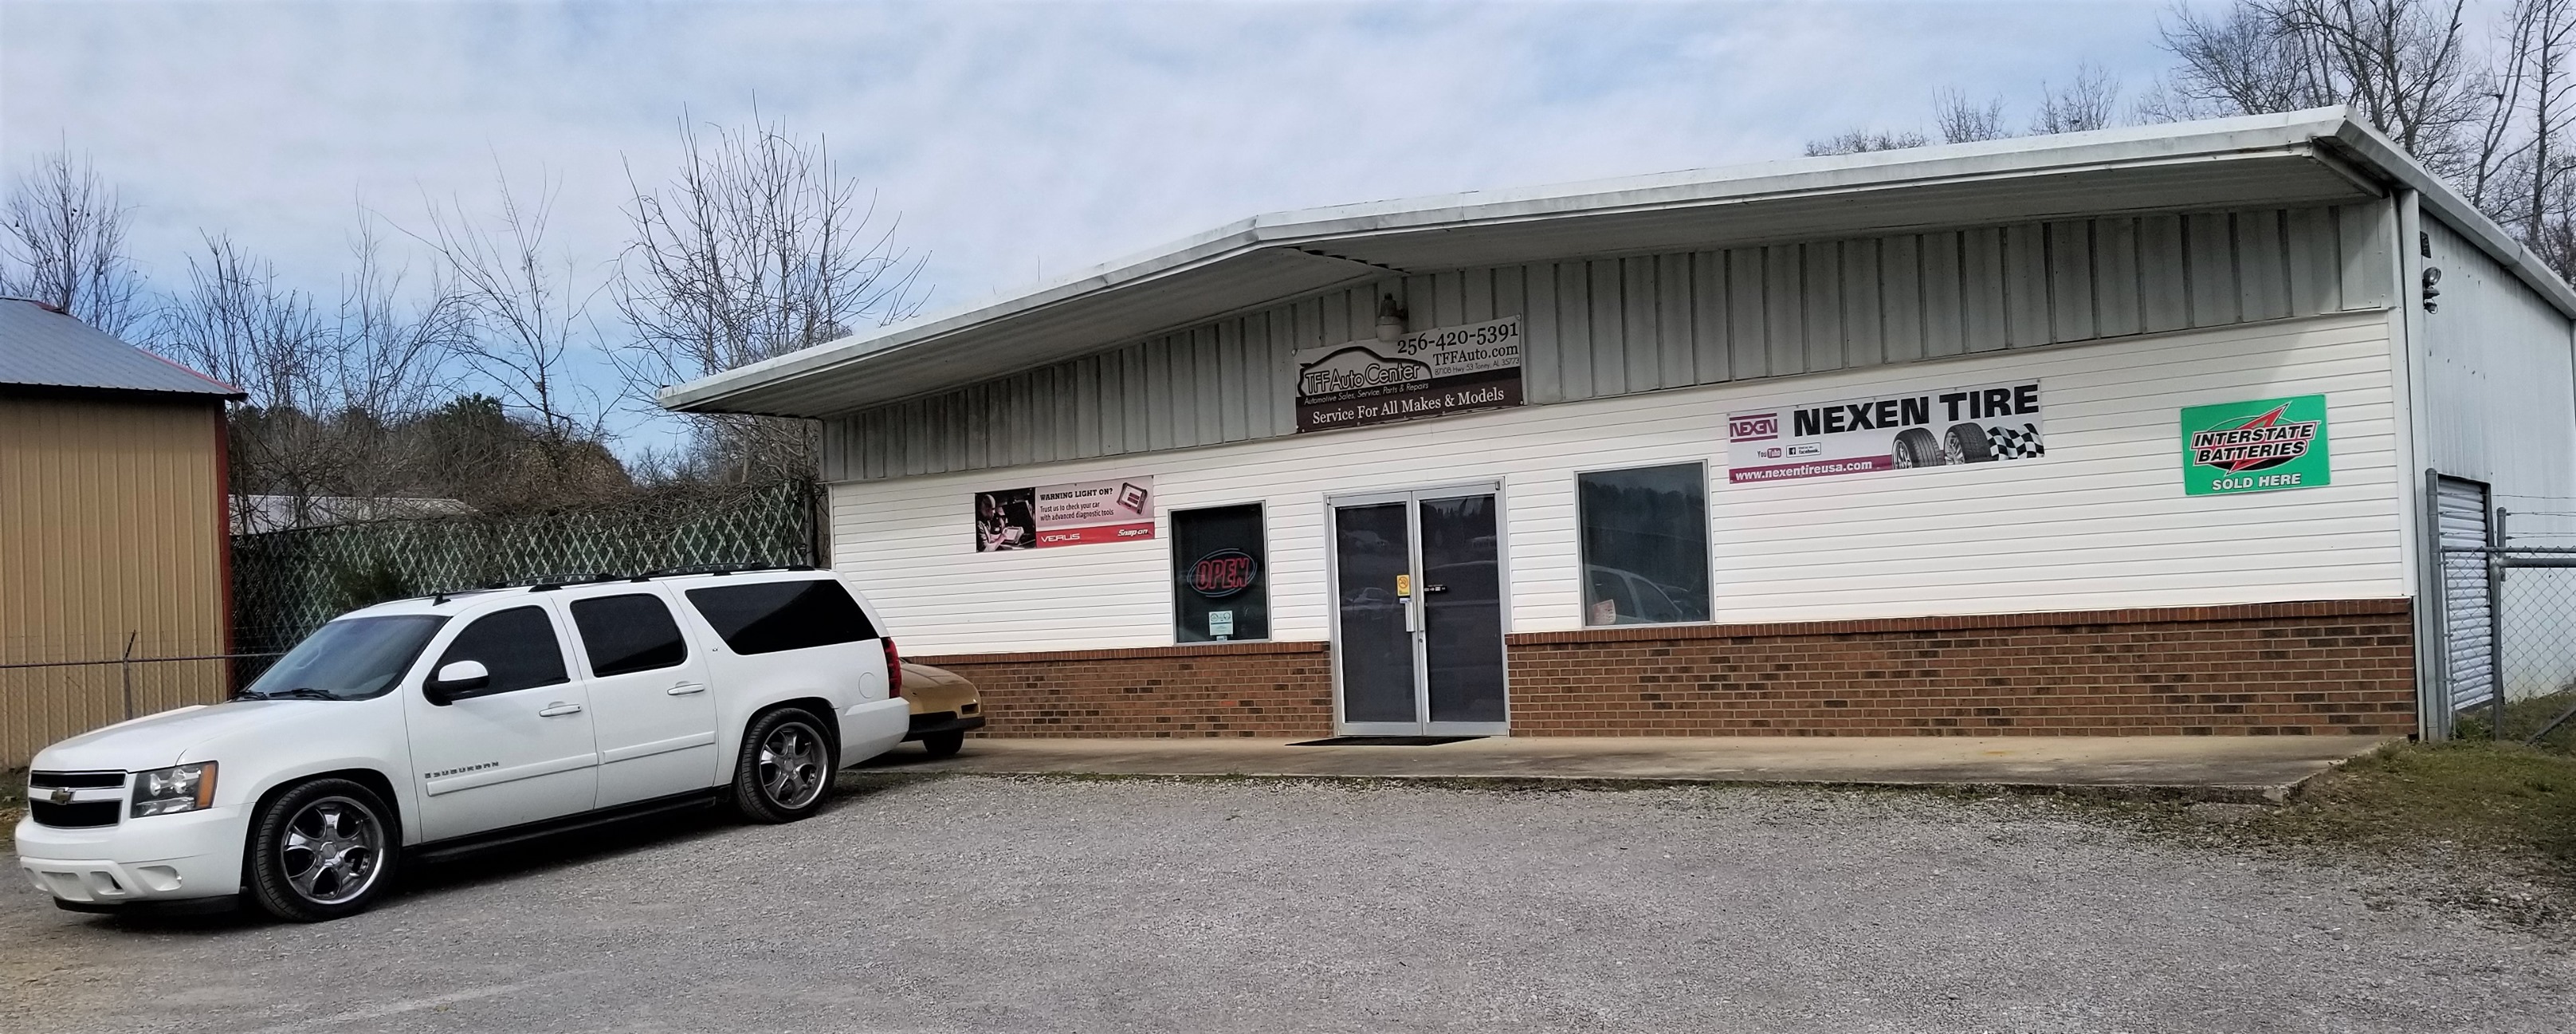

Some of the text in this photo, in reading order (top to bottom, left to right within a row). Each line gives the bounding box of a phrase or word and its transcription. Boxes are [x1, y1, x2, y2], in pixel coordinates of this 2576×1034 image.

[1397, 322, 1518, 356] 256-420-5391
[1433, 345, 1518, 366] TFFAuto.com
[1365, 360, 1420, 385] Center
[1304, 395, 1337, 405] Automotive
[1338, 391, 1355, 400] Sales,
[1383, 386, 1397, 395] Parts
[1407, 383, 1428, 392] Repairs
[1313, 387, 1504, 424] Service For All Makes & Models
[1794, 384, 2039, 437] NEXEN TIRE
[1730, 419, 1778, 438] NEXEN
[2194, 424, 2313, 447] INTERSTATE
[2198, 442, 2306, 462] BATTERIES
[1735, 461, 1872, 481] www.nexentireusa.com
[2212, 473, 2301, 491] SOLD HERE
[1040, 492, 1073, 501] WARNING
[1076, 509, 1101, 520] diagnostic
[1196, 557, 1250, 590] OPEN
